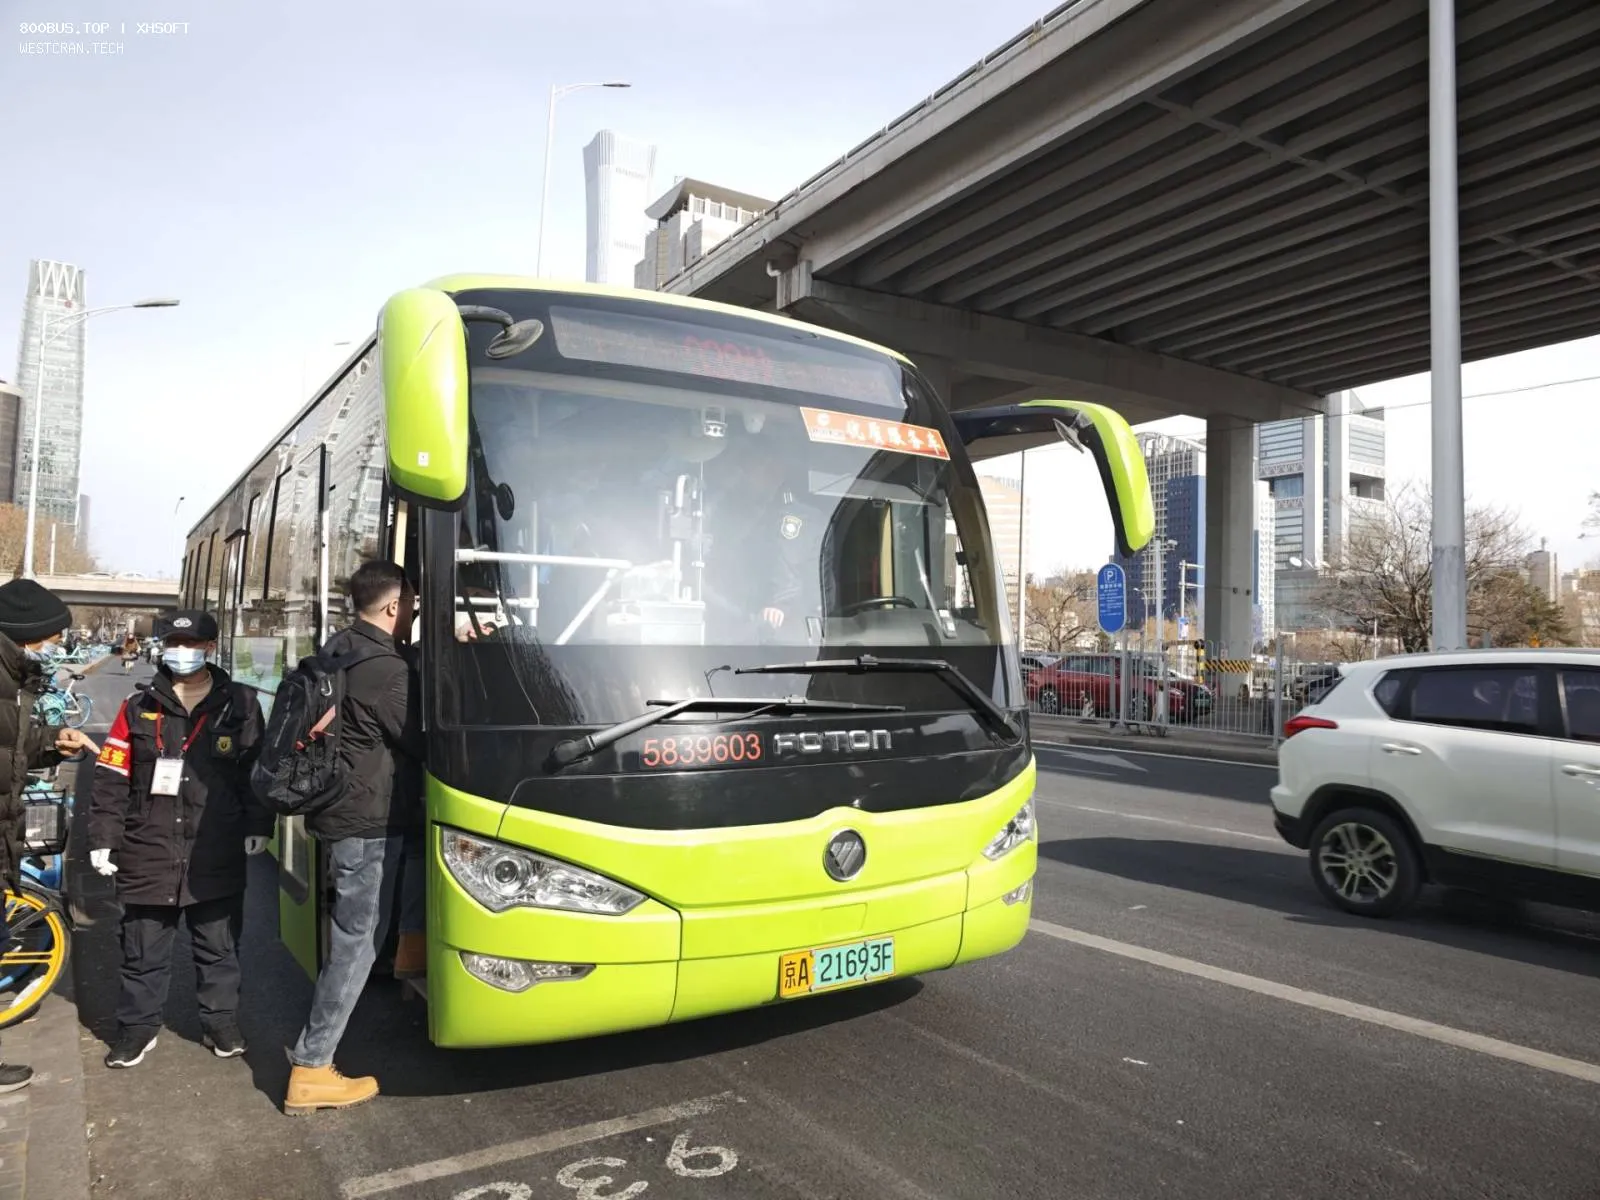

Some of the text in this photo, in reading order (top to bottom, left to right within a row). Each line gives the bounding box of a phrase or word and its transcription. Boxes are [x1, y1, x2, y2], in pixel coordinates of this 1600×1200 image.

[643, 732, 762, 767] 5839603
[784, 941, 893, 989] 京A 21693F
